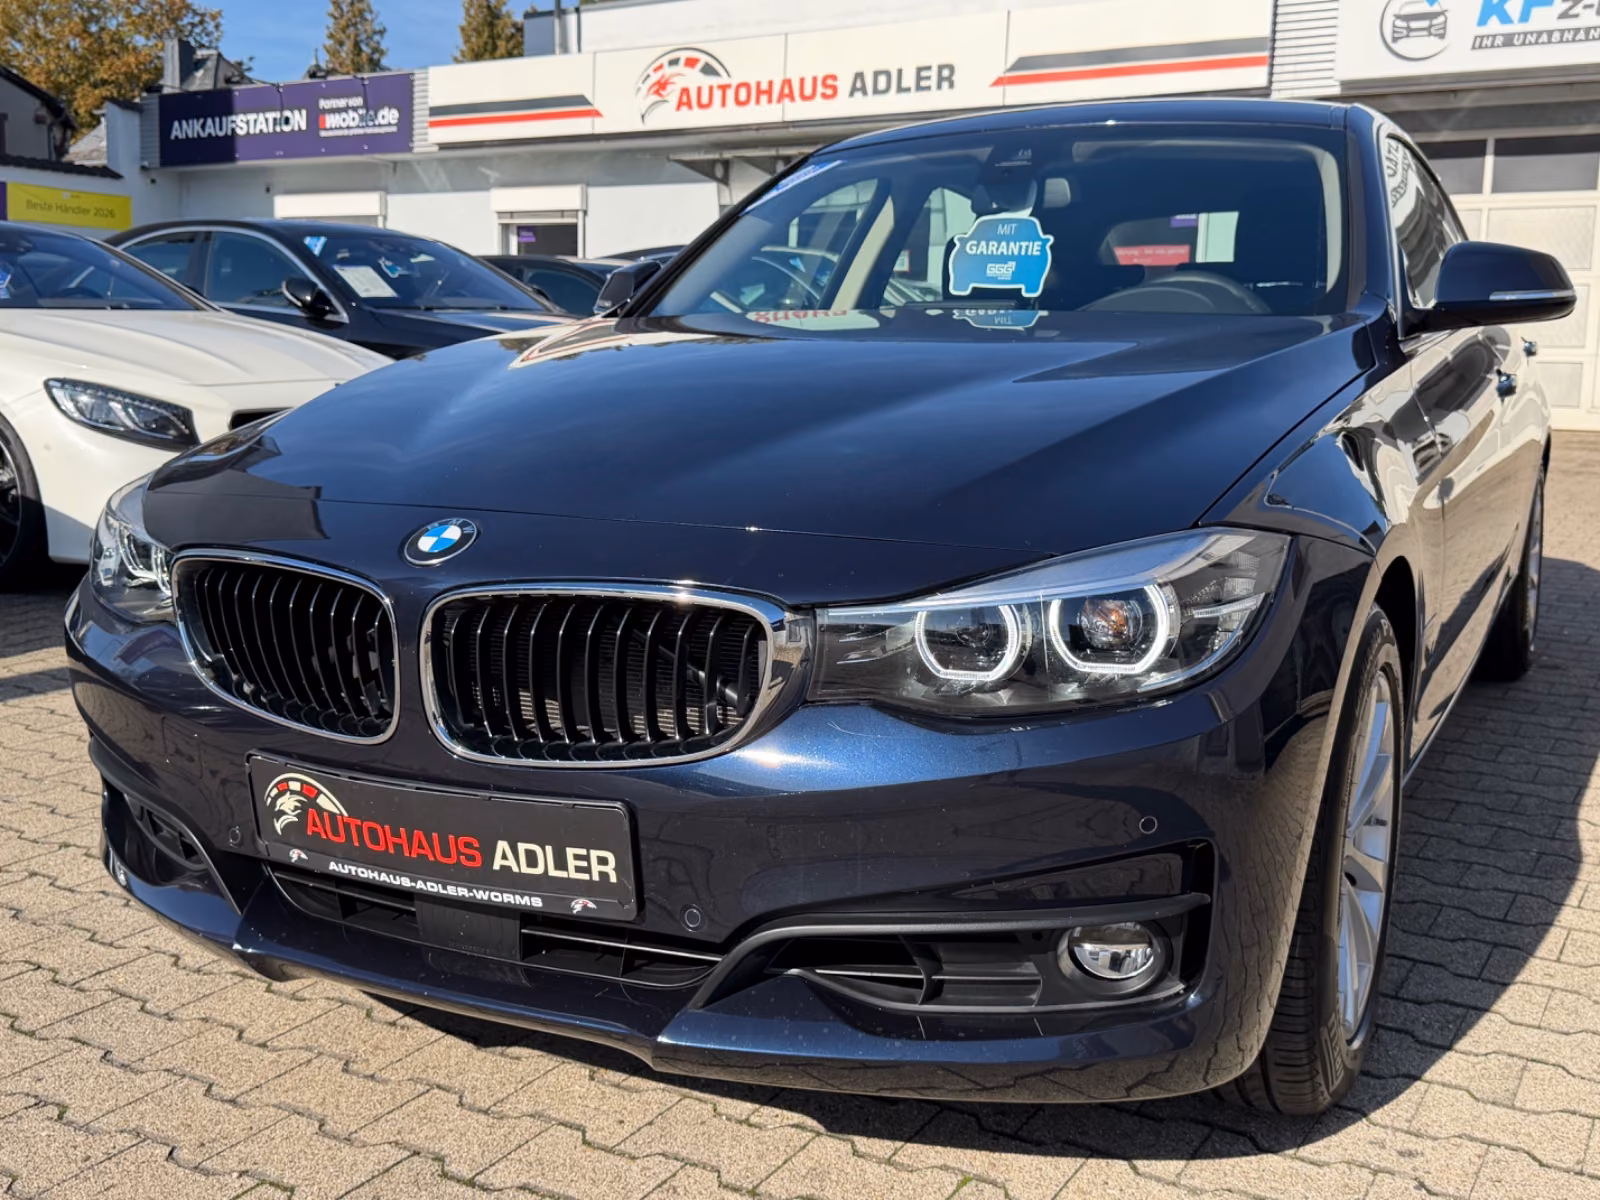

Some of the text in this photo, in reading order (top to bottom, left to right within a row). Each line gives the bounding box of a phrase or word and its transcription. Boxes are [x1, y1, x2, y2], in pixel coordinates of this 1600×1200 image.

[1475, 35, 1504, 48] IHR
[675, 63, 956, 112] AUTOHAUS ADLER
[319, 98, 347, 109] Partner
[170, 109, 307, 140] ANKAUFSTATION
[26, 199, 53, 212] Beste
[55, 203, 91, 215] Händler
[997, 224, 1017, 235] MIT
[966, 241, 1042, 256] GARANTIE
[307, 808, 618, 883] AUTOHAUS ADLER
[328, 861, 543, 908] AUTOHAUS-ADLER-WORMS
